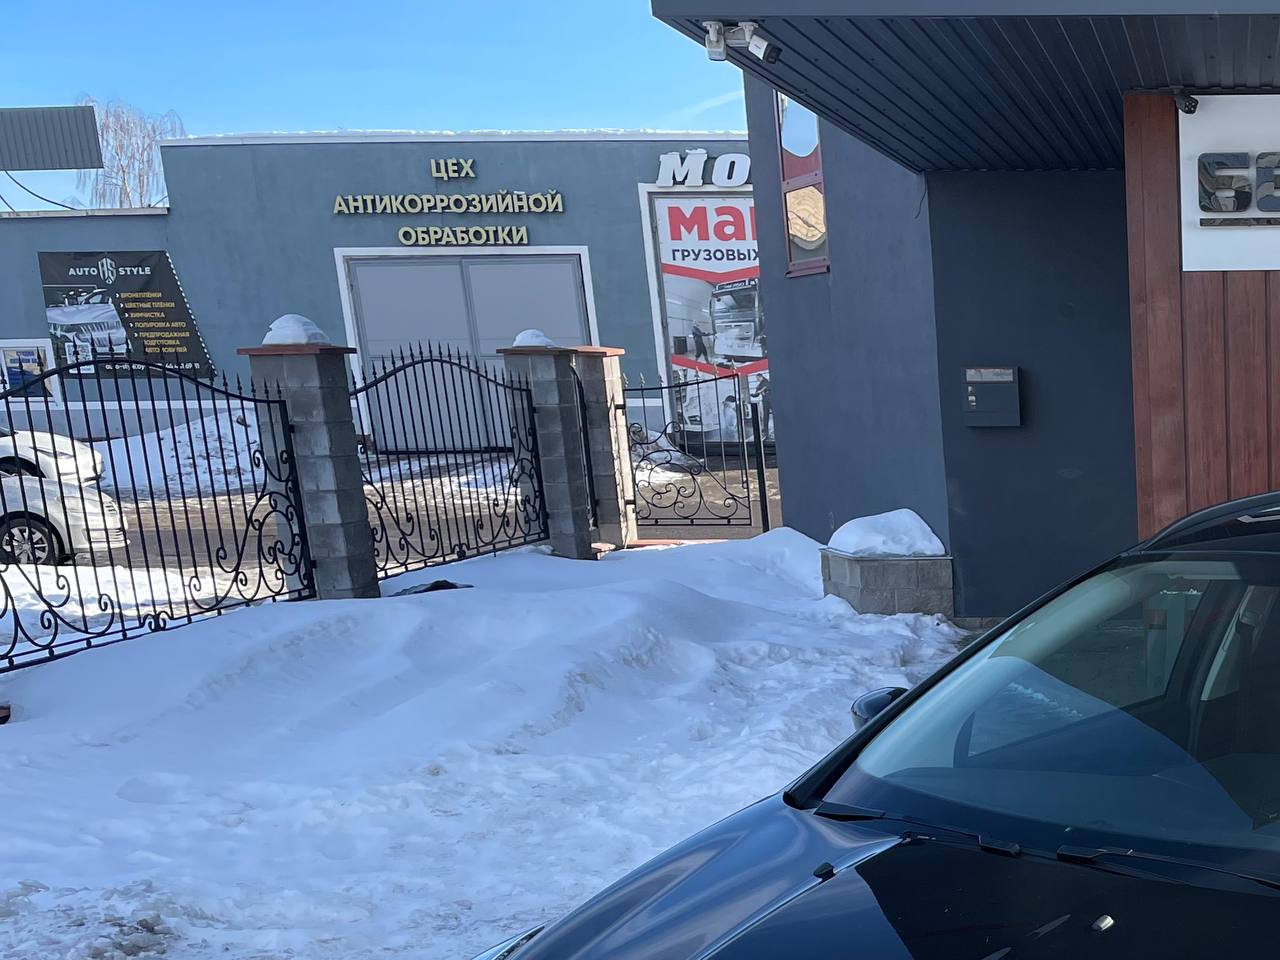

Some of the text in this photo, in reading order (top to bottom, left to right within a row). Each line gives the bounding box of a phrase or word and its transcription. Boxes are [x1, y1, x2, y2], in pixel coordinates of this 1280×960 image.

[430, 158, 476, 181] ЦЕХ
[333, 189, 563, 214] АНТИКОРРОЗИЙНОЙ
[398, 225, 529, 246] ОБРАБОТКИ
[68, 267, 98, 275] AUTO
[118, 266, 151, 275] STYLE
